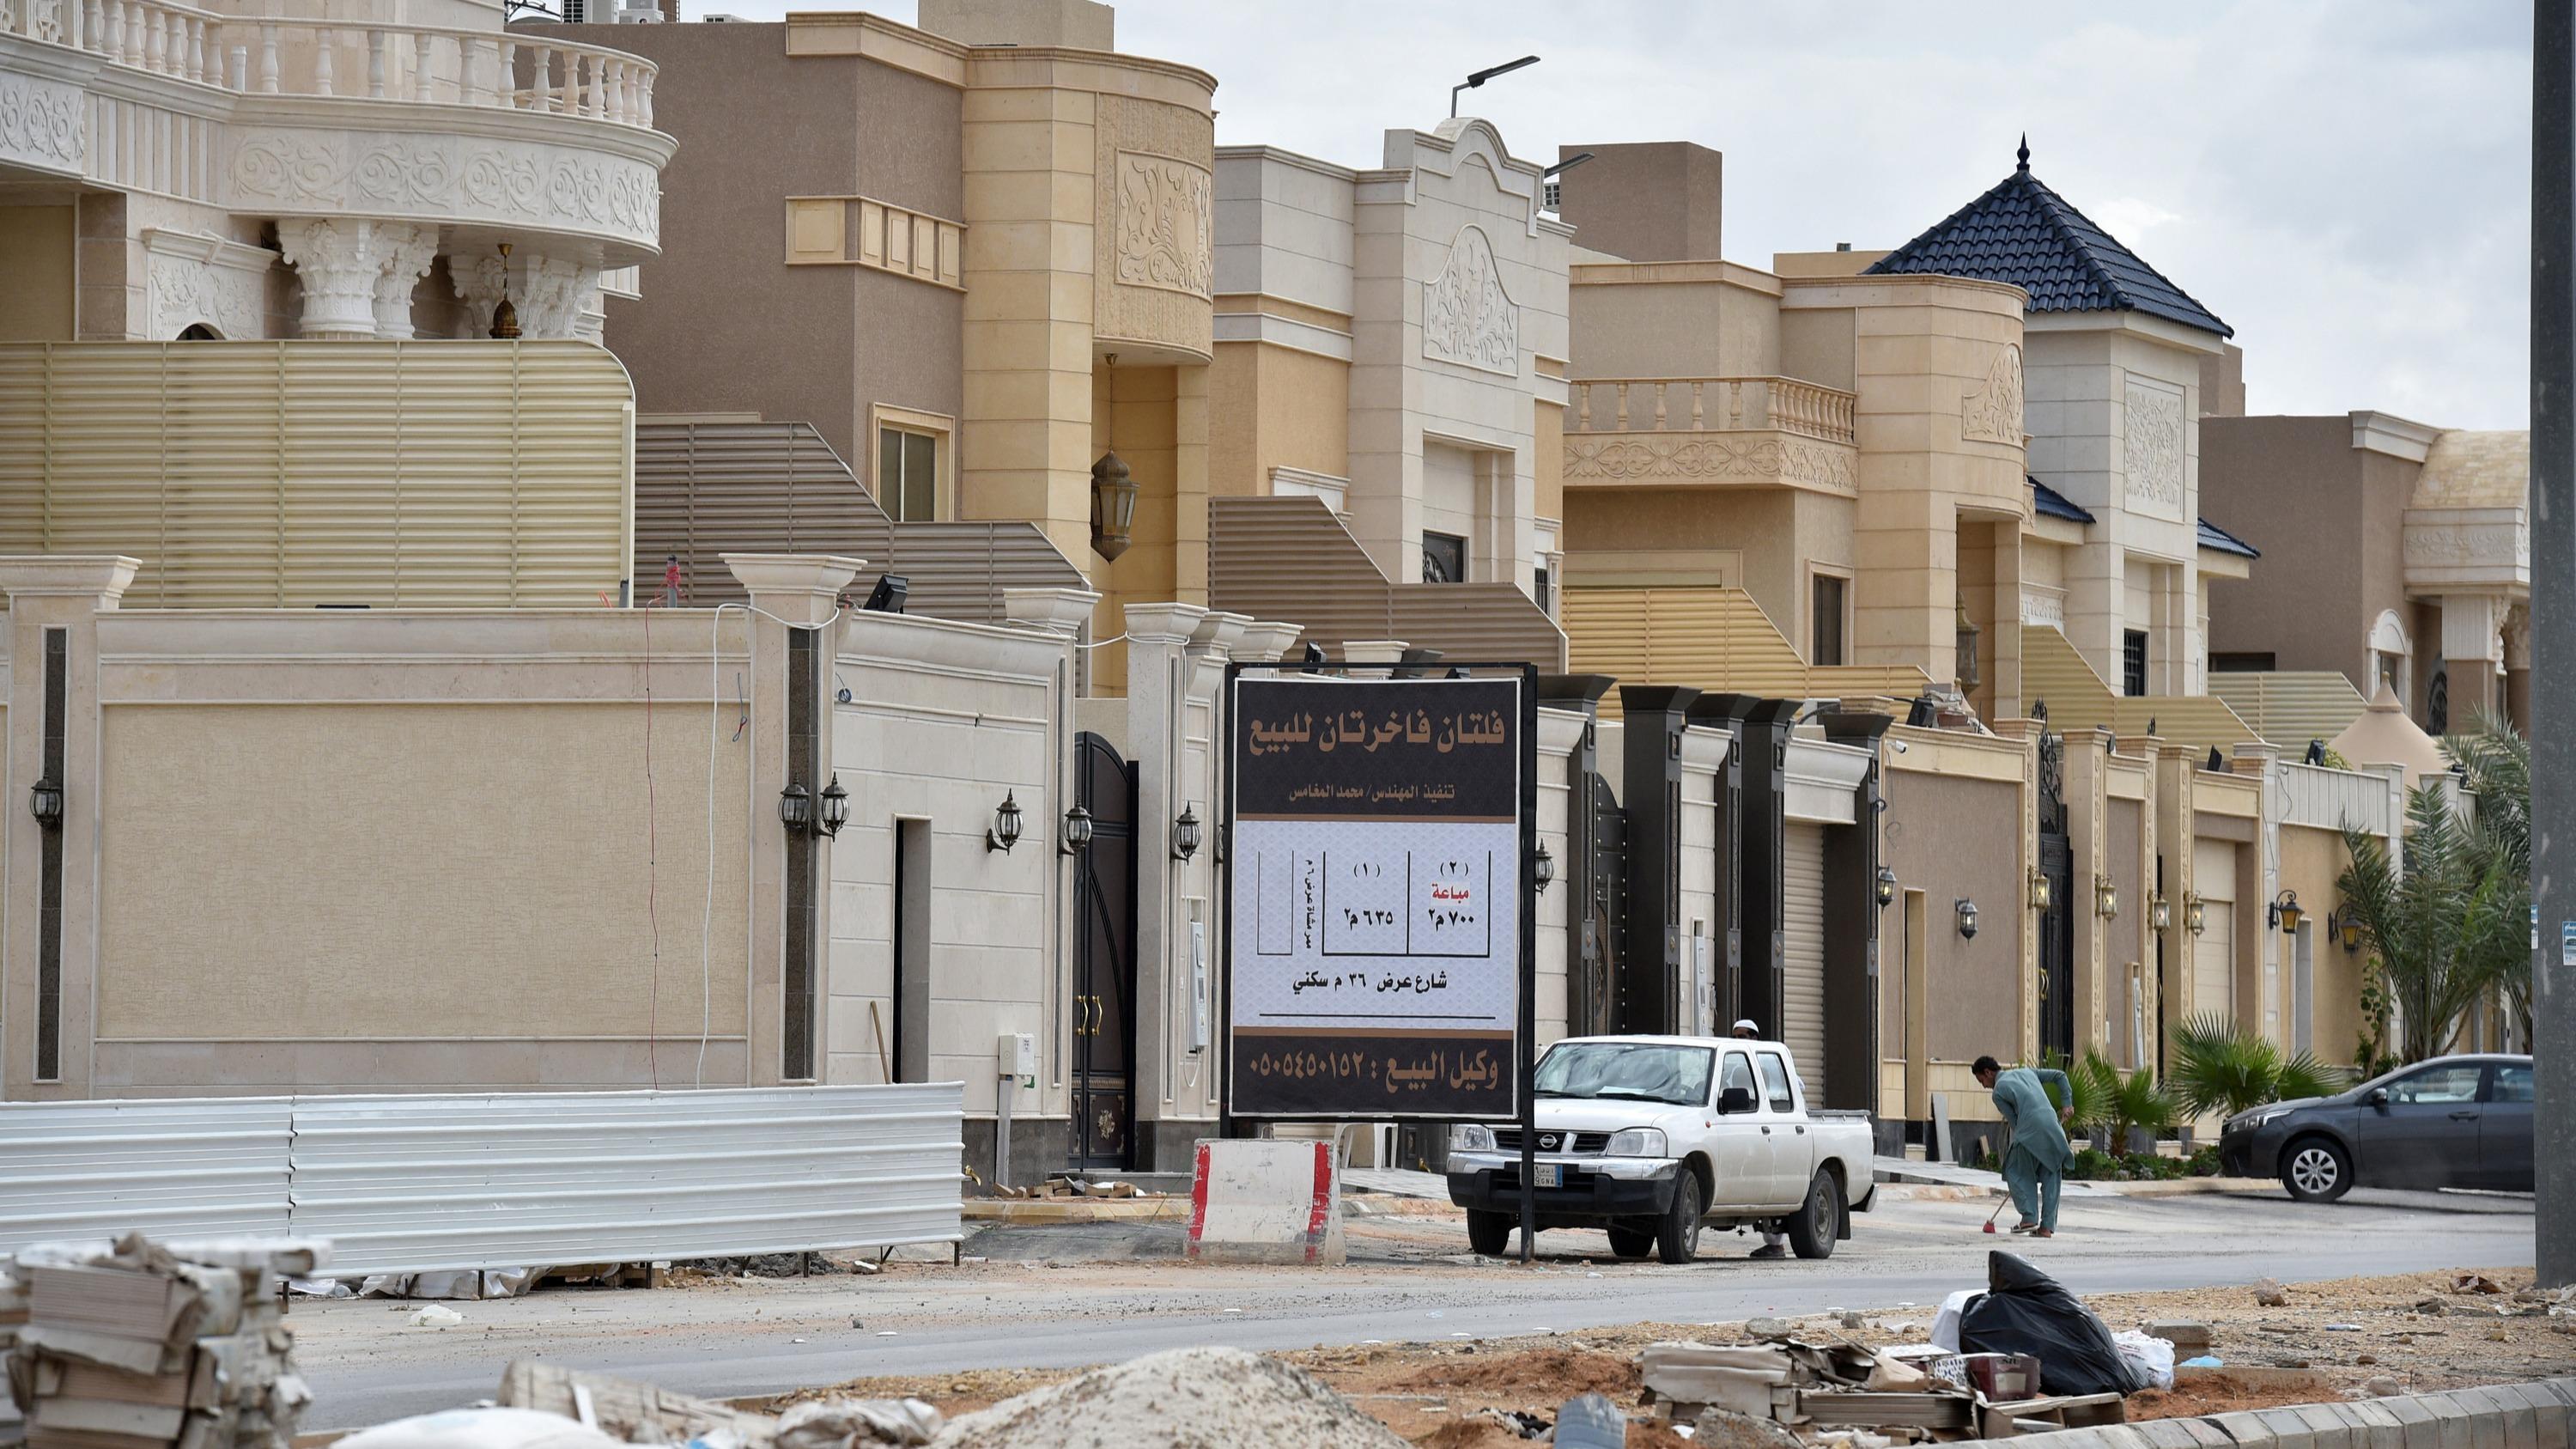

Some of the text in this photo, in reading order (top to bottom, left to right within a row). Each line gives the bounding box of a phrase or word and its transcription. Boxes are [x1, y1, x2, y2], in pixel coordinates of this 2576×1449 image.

[1249, 708, 1505, 757] فلتان فاخرتان للبيع
[1335, 782, 1364, 799] محمد
[1422, 782, 1456, 803] تنفيذ
[1304, 878, 1315, 904] عرض
[1431, 882, 1469, 904] مباعة
[1448, 910, 1474, 928] ٧٠٠
[1292, 970, 1448, 995] شارع عرض ٣٦ م سكني
[1249, 1050, 1364, 1080] ٠٥٠٥٤٥٠١٥٢
[1385, 1050, 1445, 1094] البيع
[1449, 1048, 1499, 1093] وكيل
